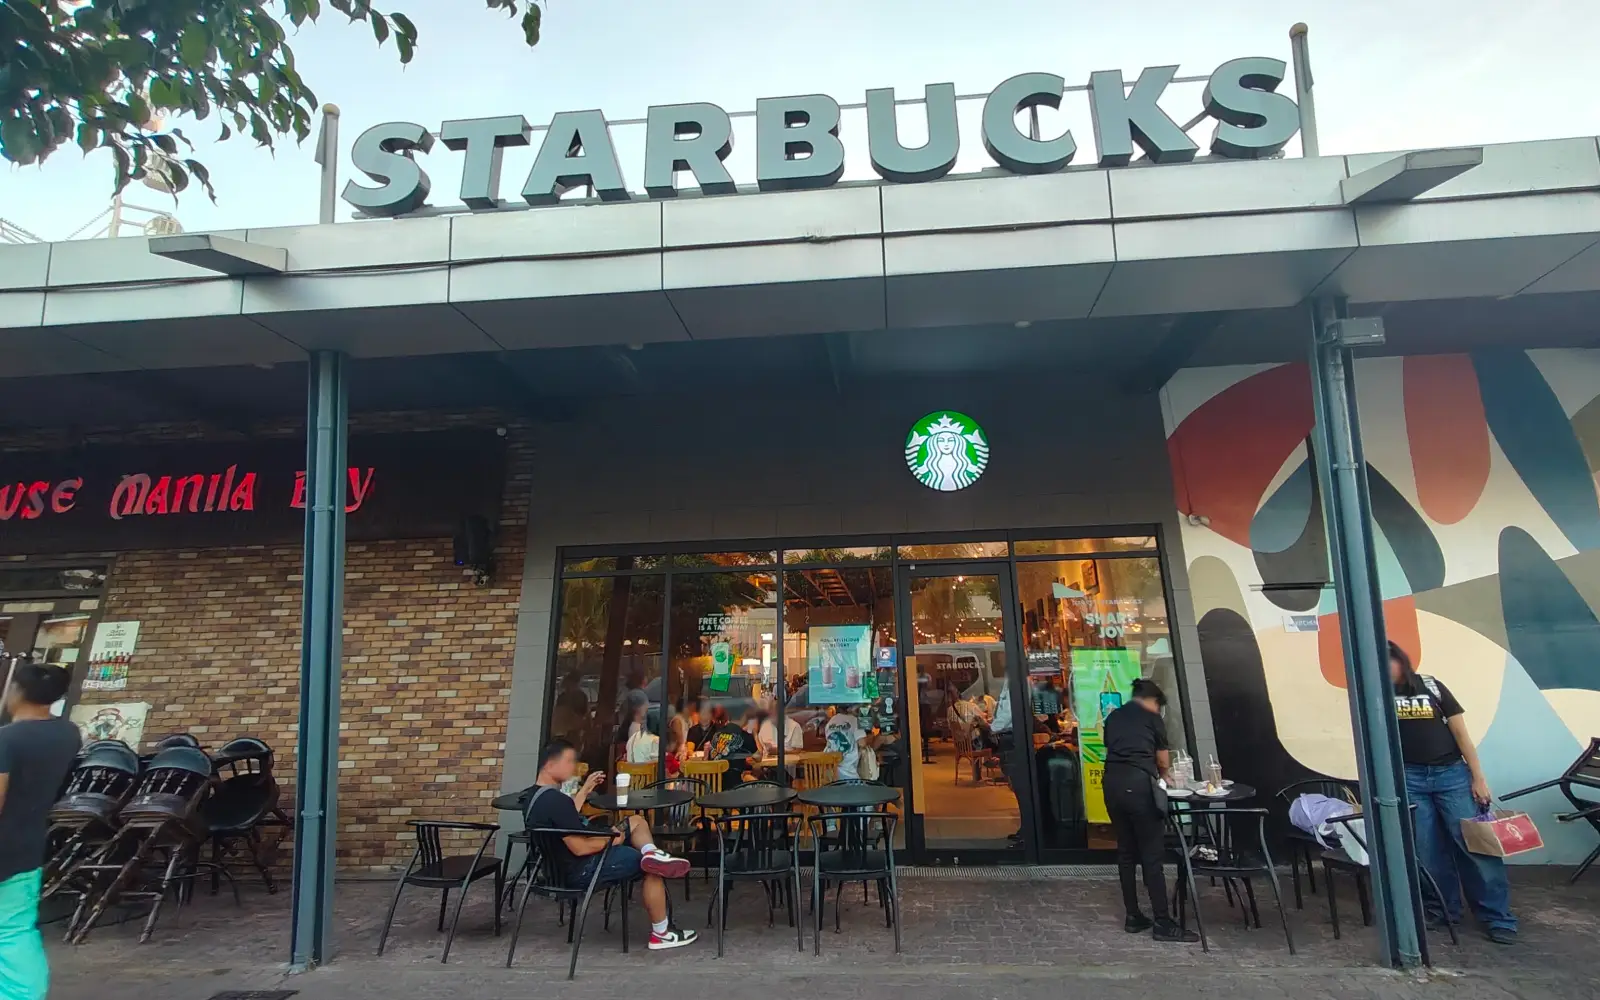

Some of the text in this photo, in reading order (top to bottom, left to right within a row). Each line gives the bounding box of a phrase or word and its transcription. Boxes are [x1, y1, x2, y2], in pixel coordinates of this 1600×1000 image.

[341, 56, 1300, 217] STARBUCKS
[698, 617, 717, 625] FREE
[1085, 612, 1135, 625] SHAR
[1099, 625, 1125, 639] JOY
[936, 661, 985, 670] STARBUCKS
